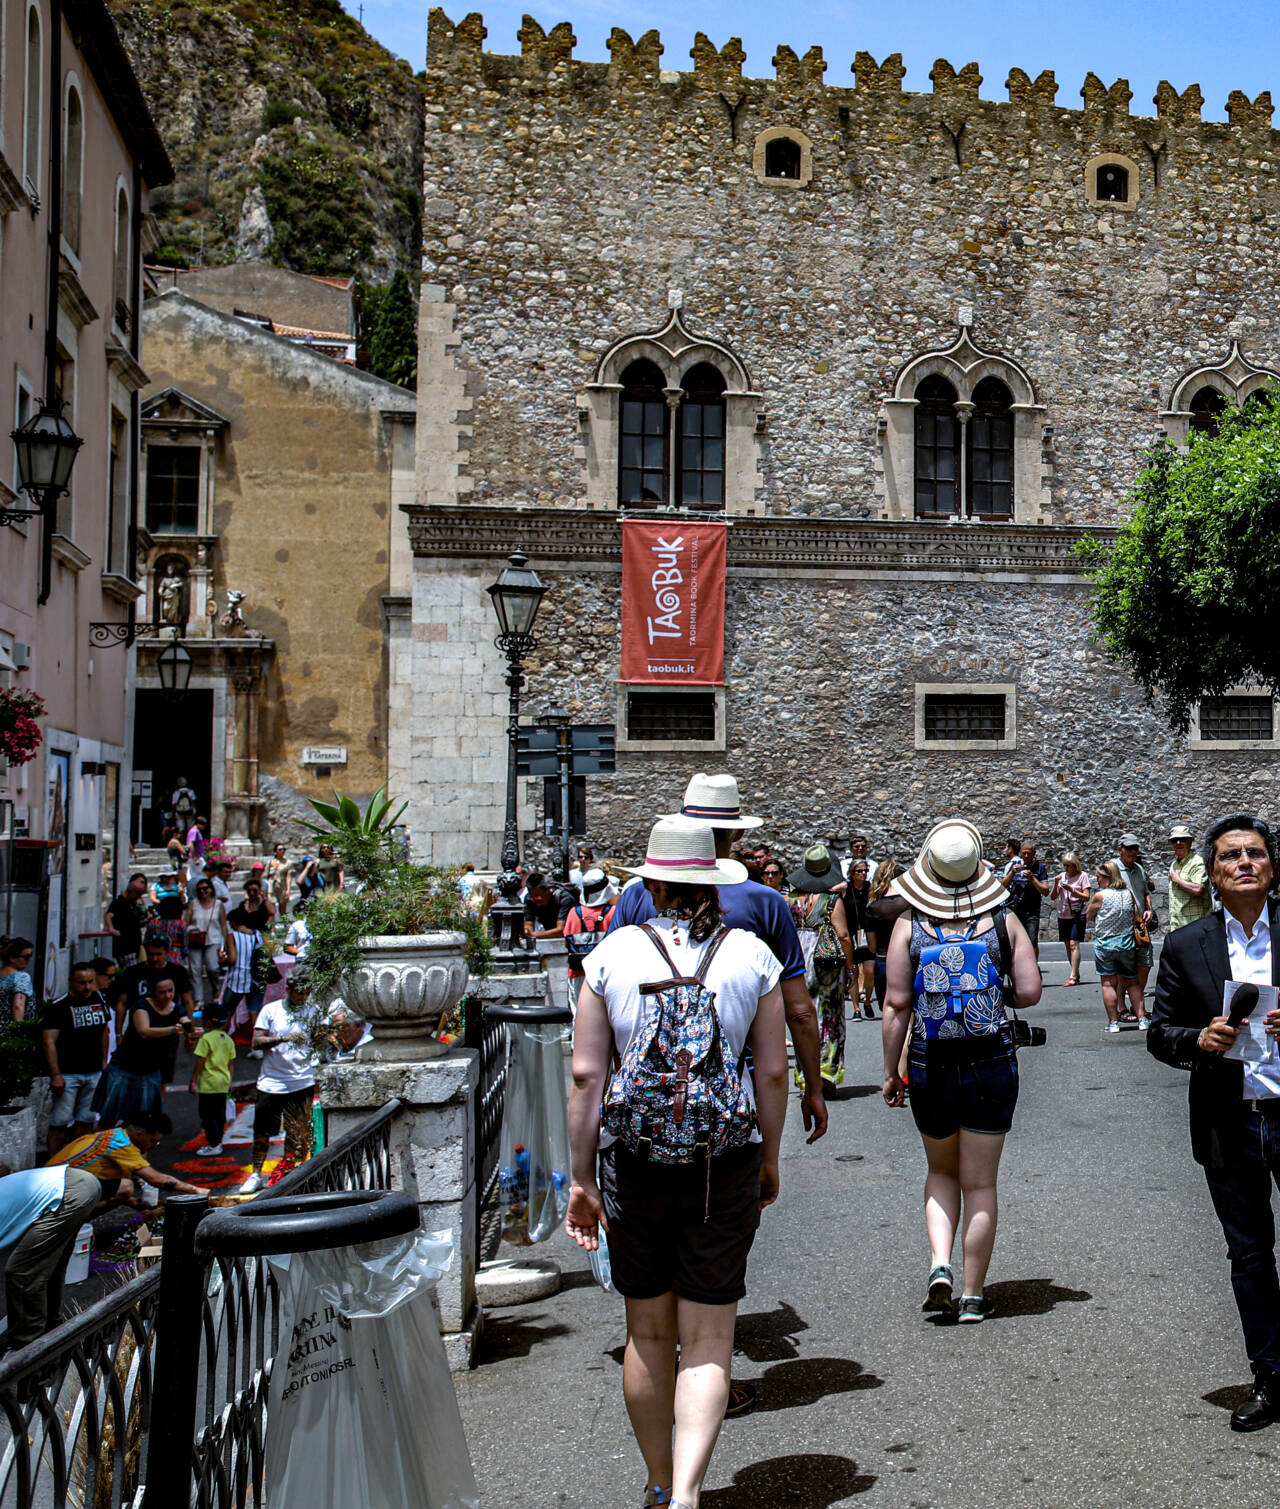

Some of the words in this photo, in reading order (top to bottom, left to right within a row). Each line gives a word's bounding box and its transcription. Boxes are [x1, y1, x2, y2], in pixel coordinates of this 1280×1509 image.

[691, 535, 699, 574] FESTIVAL
[690, 575, 699, 600] BOOK
[689, 601, 698, 647] TAORMINA
[647, 663, 695, 674] taobuk.it
